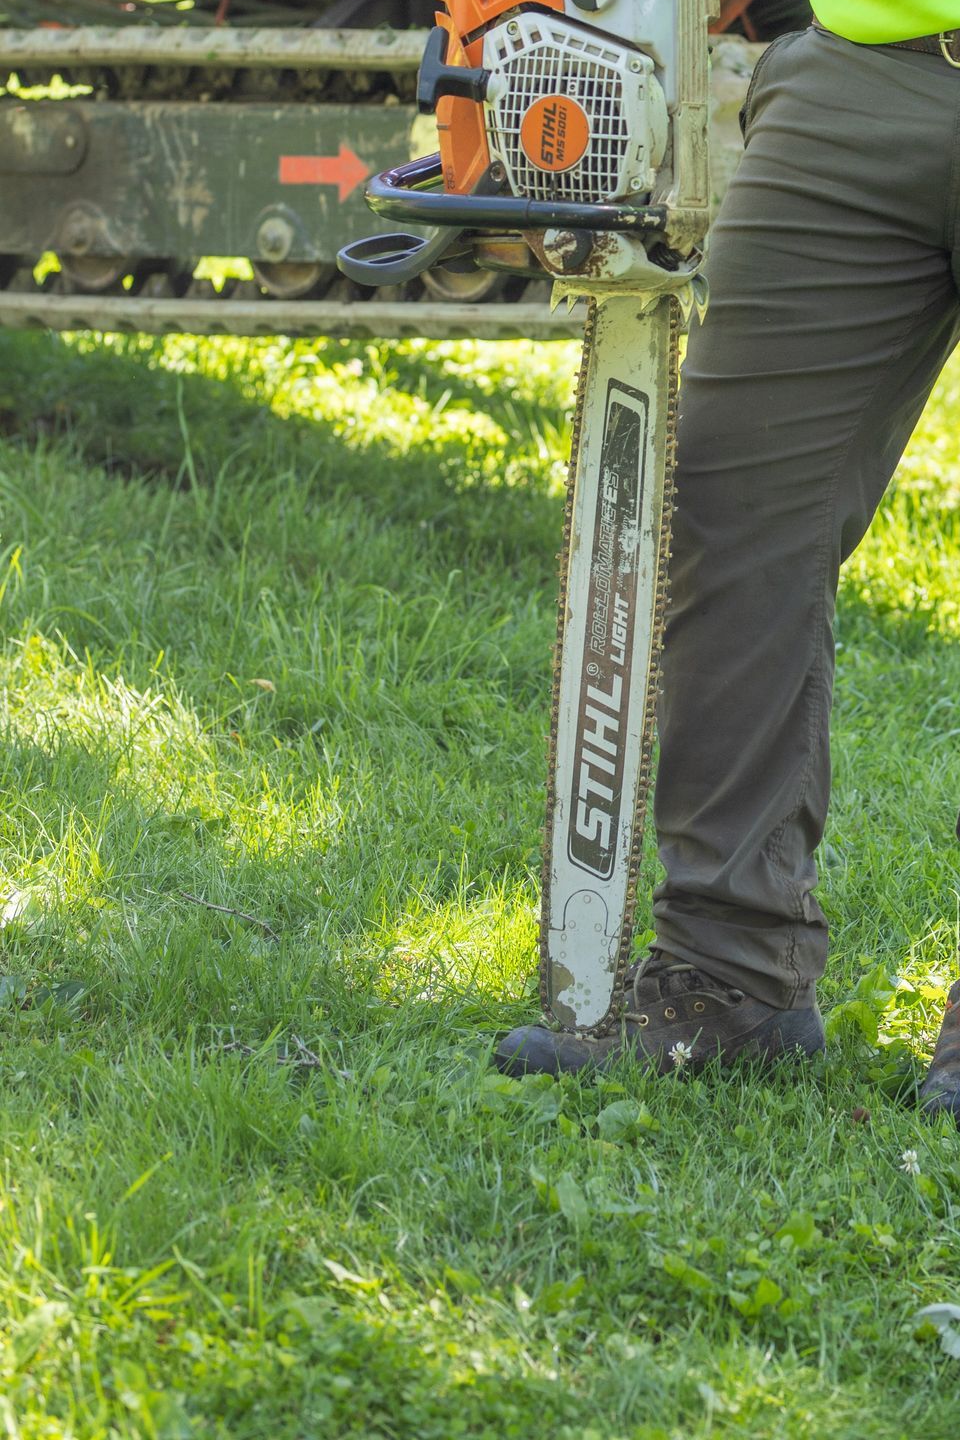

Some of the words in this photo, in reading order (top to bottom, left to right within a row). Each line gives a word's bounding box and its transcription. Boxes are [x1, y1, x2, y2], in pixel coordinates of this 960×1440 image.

[541, 103, 557, 165] STIHL
[556, 139, 565, 162] MS
[591, 504, 616, 655] ROLLOMATIC
[610, 592, 630, 666] LIGHT
